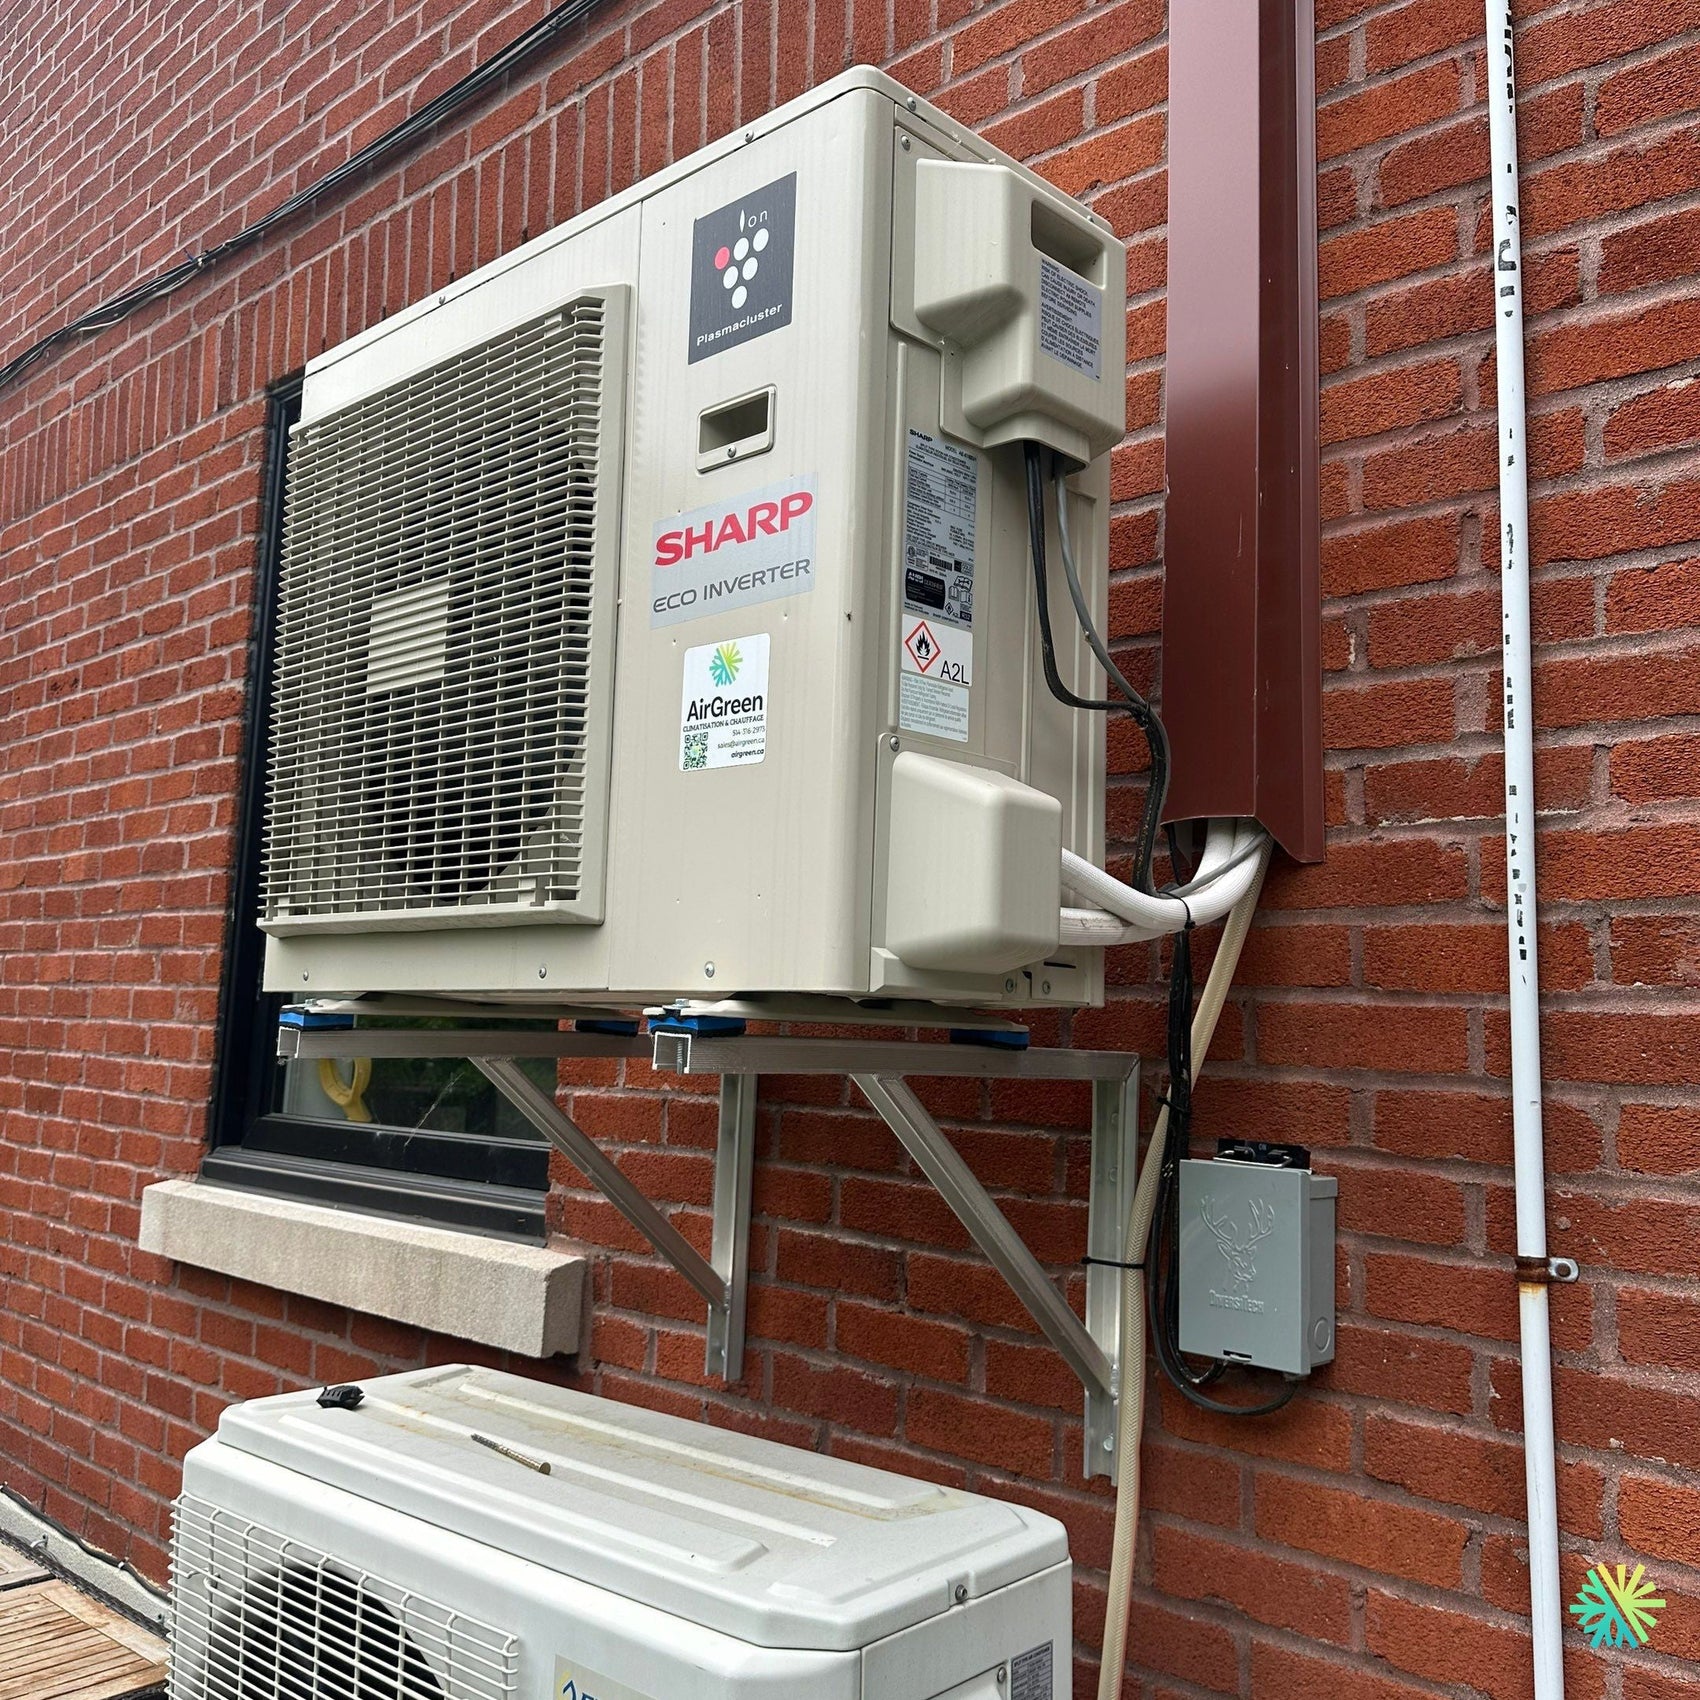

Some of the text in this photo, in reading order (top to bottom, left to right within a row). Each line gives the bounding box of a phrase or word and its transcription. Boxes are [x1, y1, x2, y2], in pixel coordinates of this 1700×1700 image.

[740, 209, 768, 233] Ion
[1041, 272, 1049, 280] CAN
[1050, 277, 1062, 288] CAUSE
[1063, 285, 1076, 295] INJURY
[697, 304, 782, 346] Plasmacluster
[910, 429, 933, 442] SHARP
[655, 492, 812, 566] SHARP
[653, 559, 810, 613] ECO INVERTER
[940, 660, 969, 685] A2L
[687, 695, 763, 722] AirGreen
[683, 714, 764, 733] CLIMATISATION & CHAUFFAGE
[717, 737, 765, 749] sales@airgreen.ca
[731, 748, 765, 759] airgreen.ca
